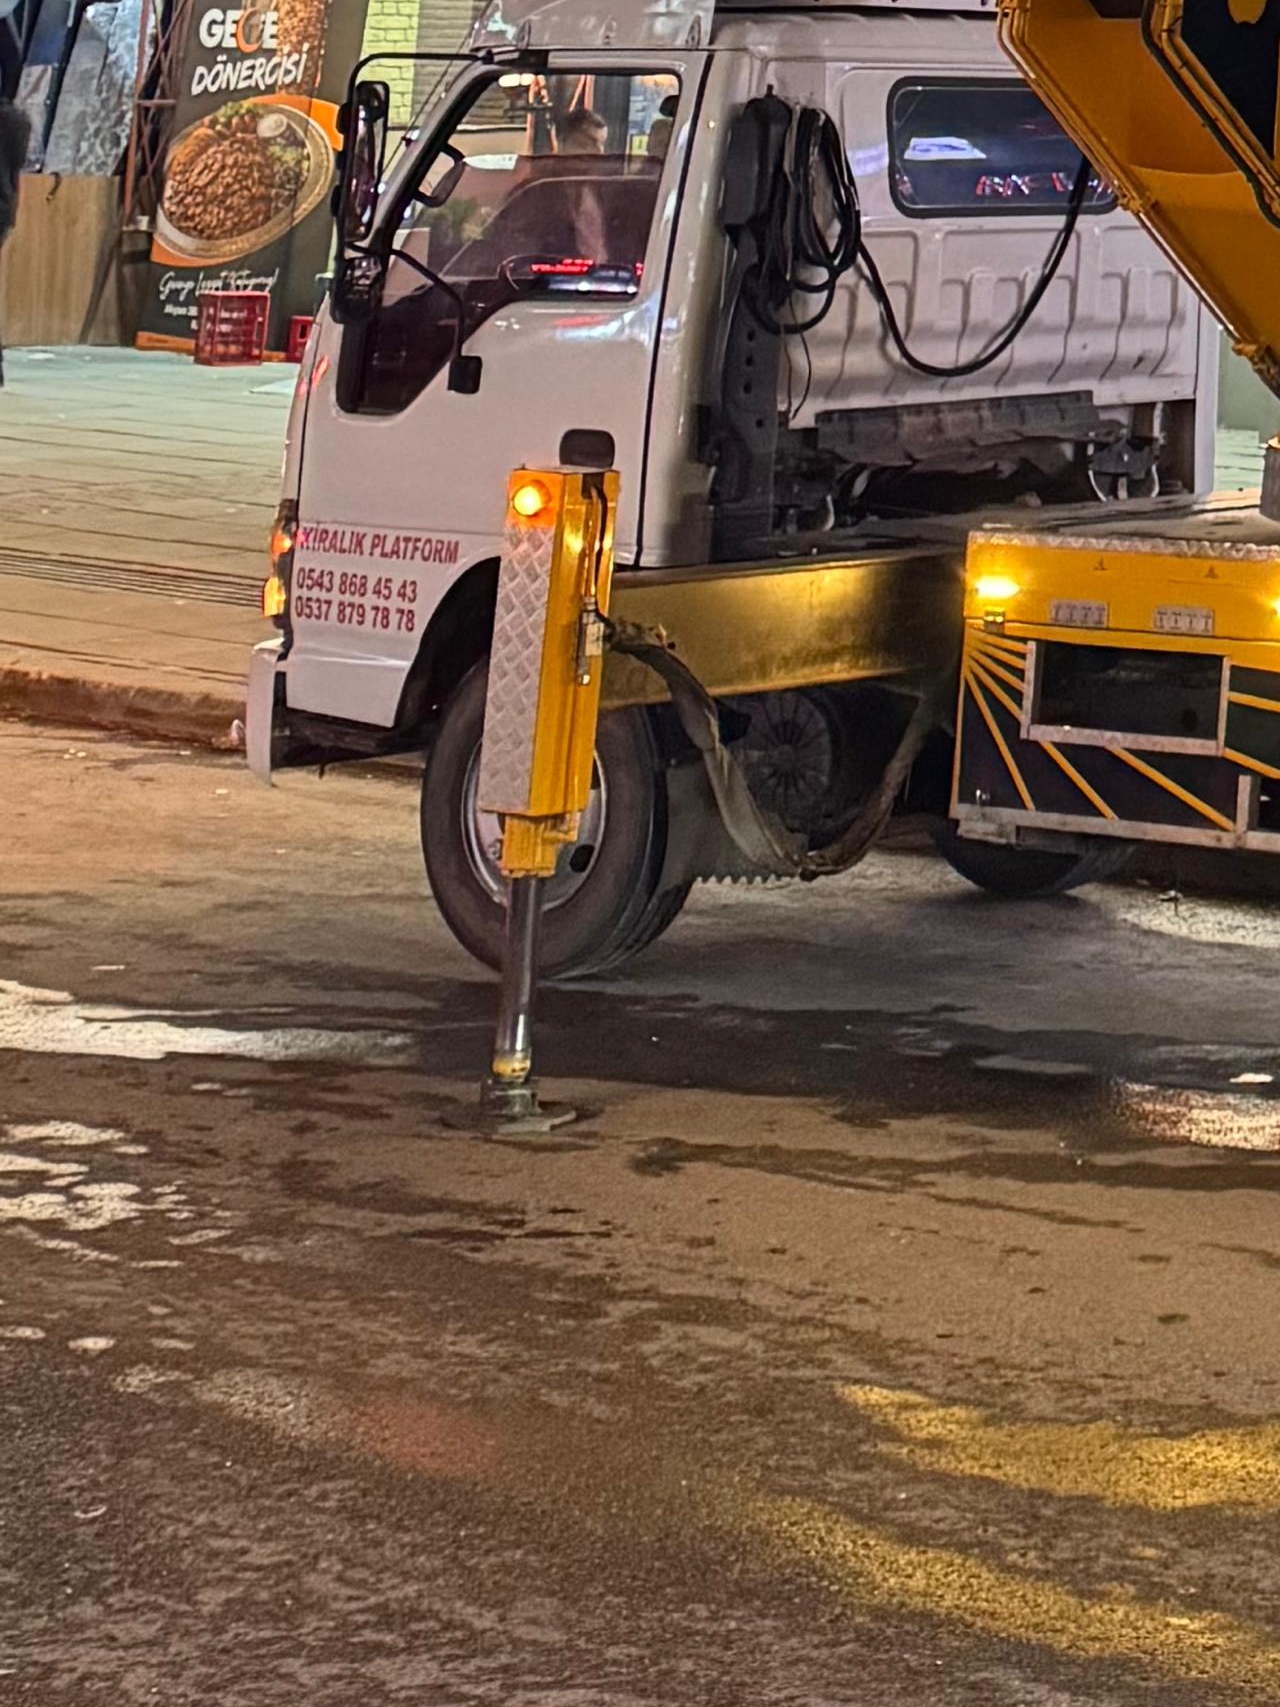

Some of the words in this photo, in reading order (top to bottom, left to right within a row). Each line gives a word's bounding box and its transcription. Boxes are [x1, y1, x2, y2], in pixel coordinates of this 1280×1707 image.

[369, 533, 460, 565] PLATFORM
[297, 567, 335, 593] 0543
[338, 574, 368, 599] 868
[372, 578, 393, 601] 45
[397, 580, 418, 603] 43
[295, 596, 332, 621] 0537
[337, 601, 366, 627] 879
[370, 605, 390, 630] 78
[395, 609, 415, 633] 78
